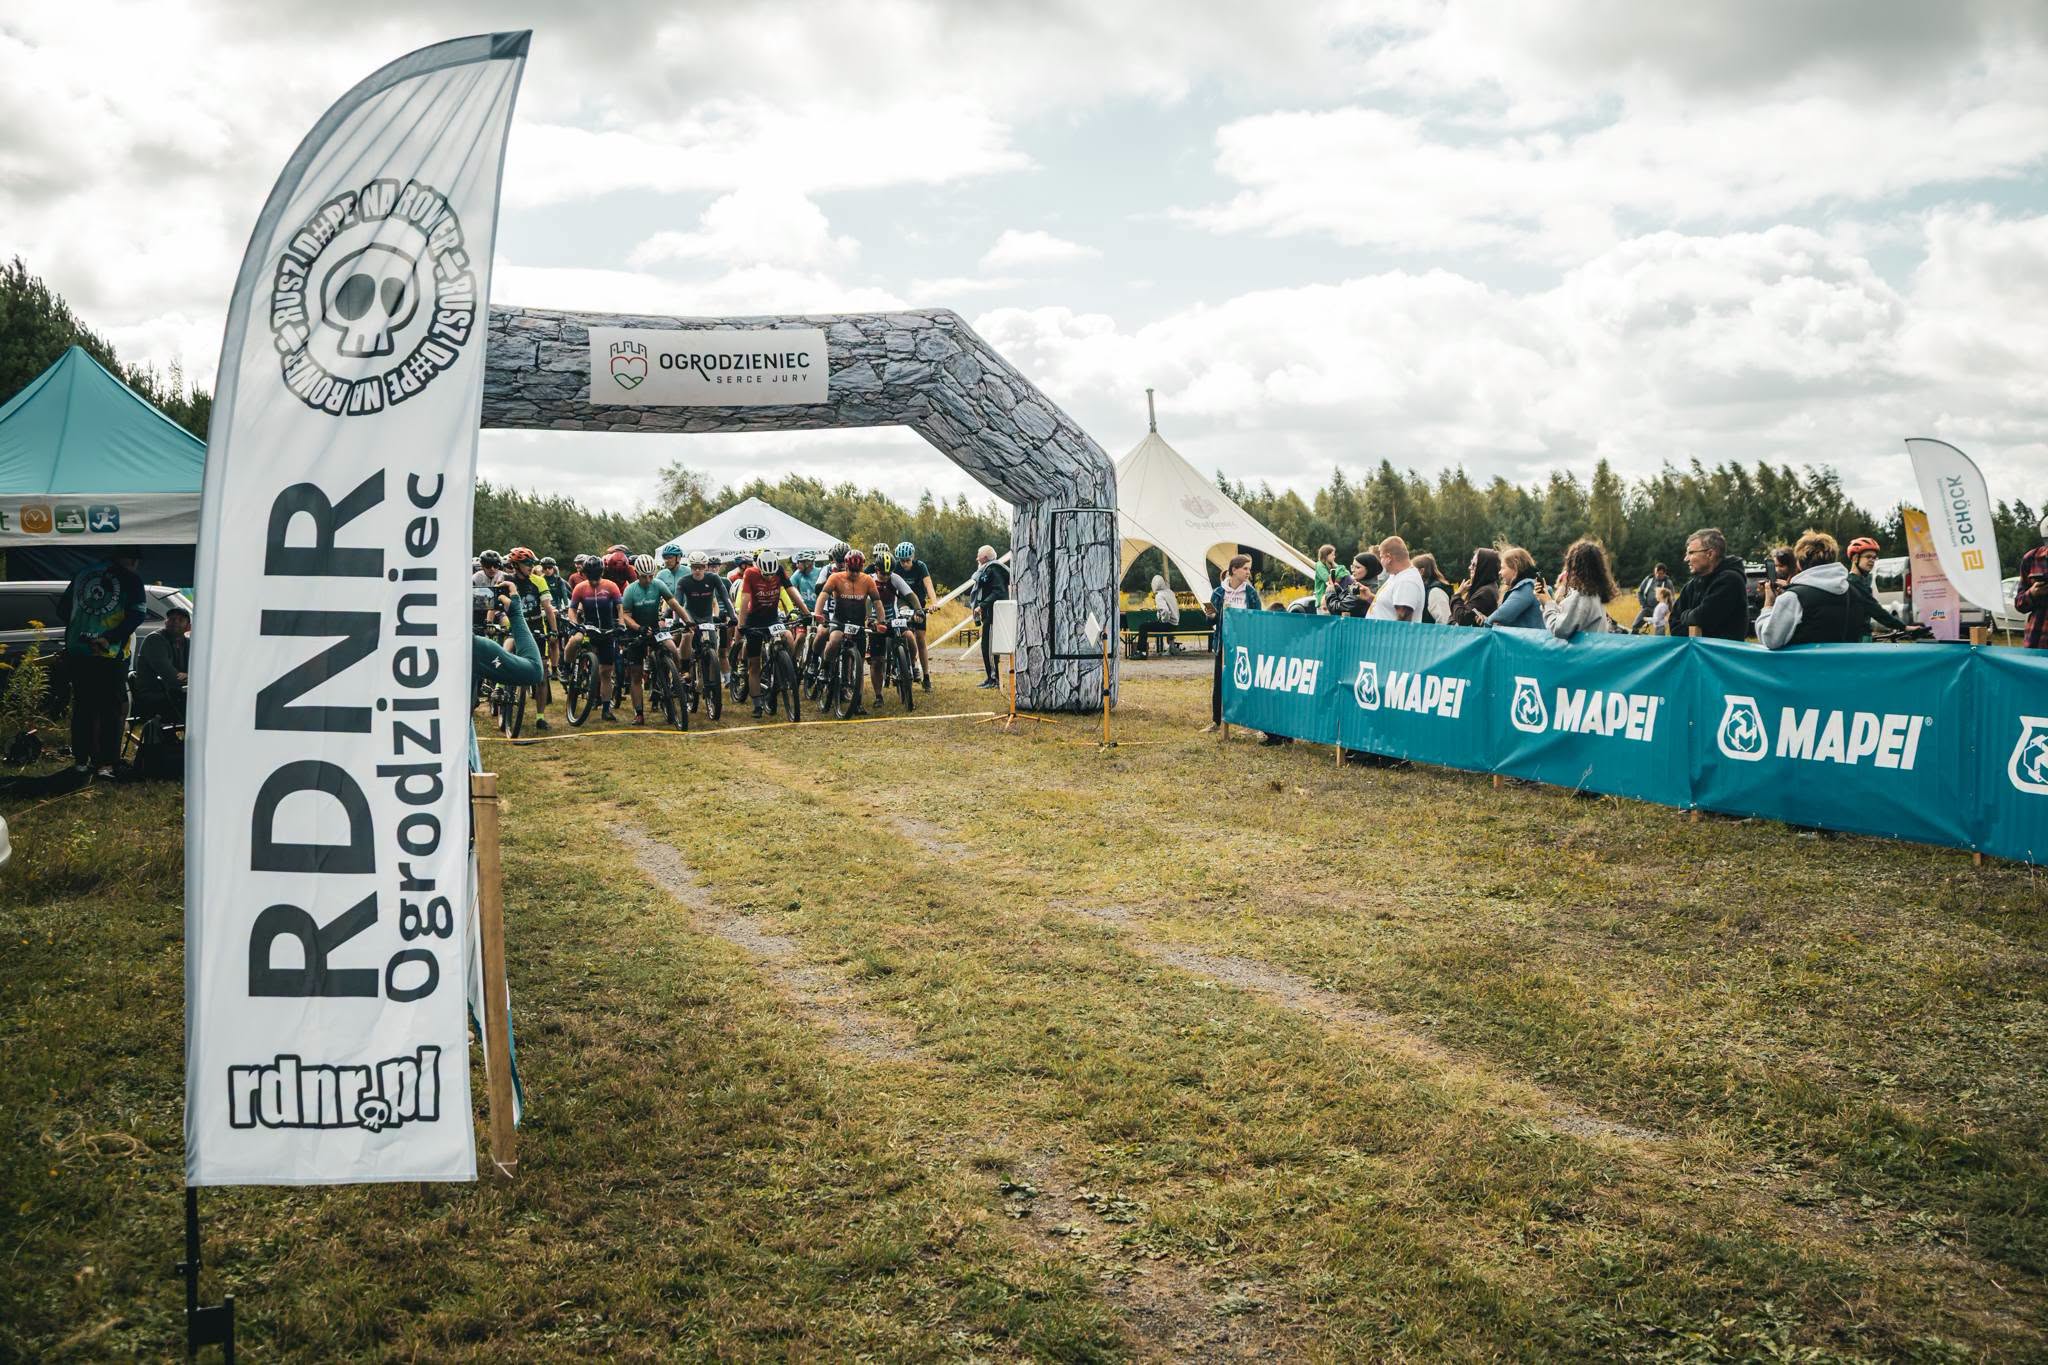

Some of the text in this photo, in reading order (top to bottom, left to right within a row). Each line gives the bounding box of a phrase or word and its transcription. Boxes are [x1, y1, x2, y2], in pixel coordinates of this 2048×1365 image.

[360, 180, 400, 221] NA
[660, 352, 810, 381] OGRODZIENIEC
[716, 373, 808, 384] SERCE JURY
[348, 376, 384, 415] NA
[248, 467, 385, 999] RDNR
[376, 472, 454, 1003] Ogrodzieniec
